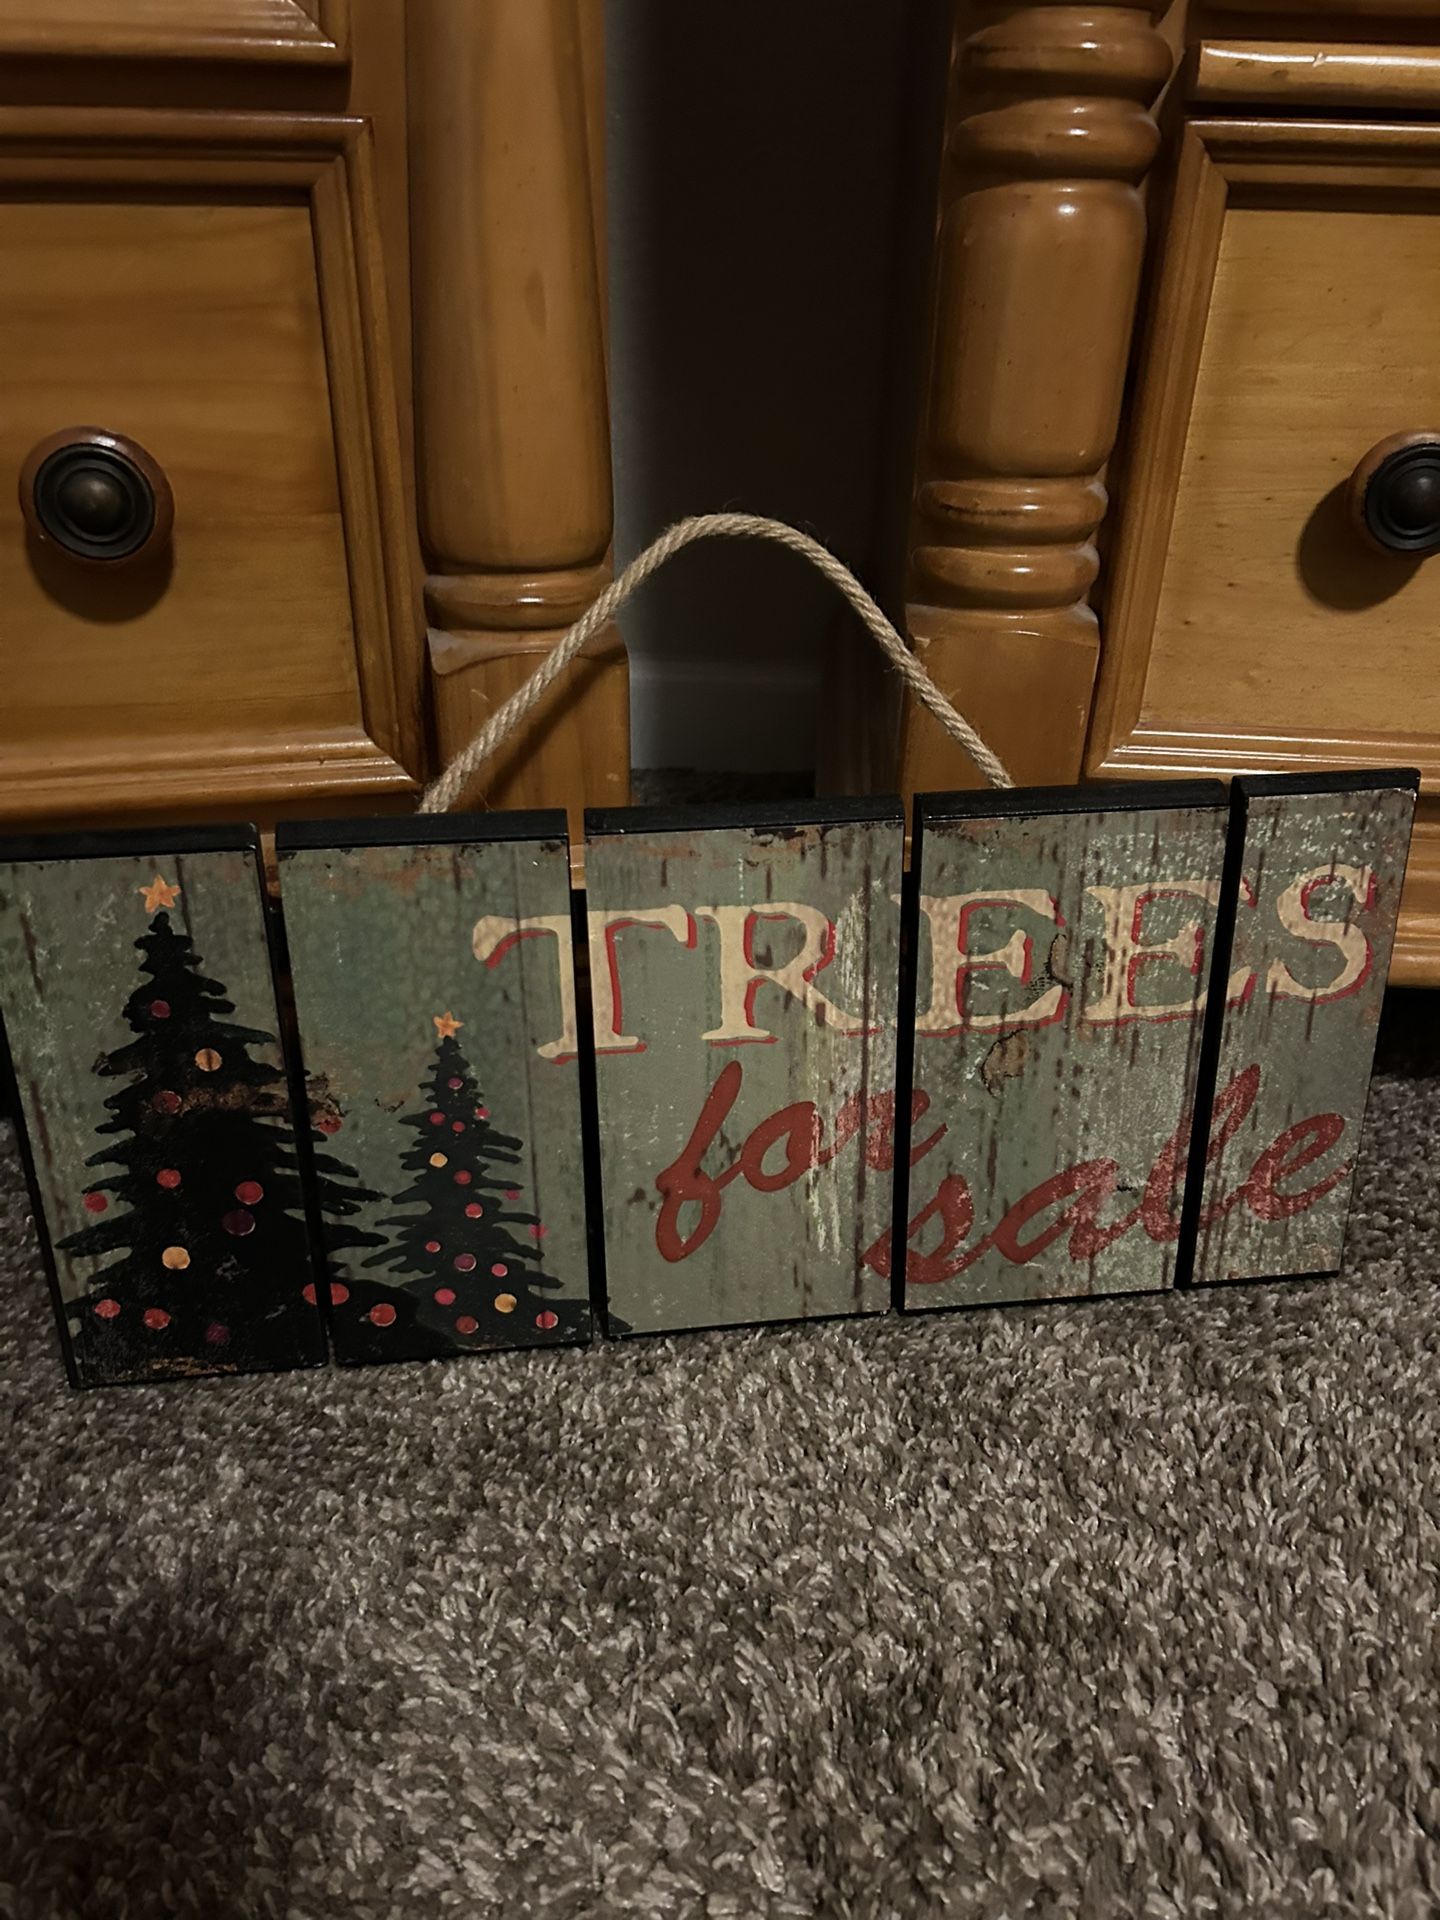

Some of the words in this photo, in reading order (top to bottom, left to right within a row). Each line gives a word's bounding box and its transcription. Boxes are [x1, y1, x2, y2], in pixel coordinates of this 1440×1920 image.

[472, 863, 1377, 1063] TREES
[655, 1061, 948, 1262] for
[860, 1063, 1354, 1283] sale
